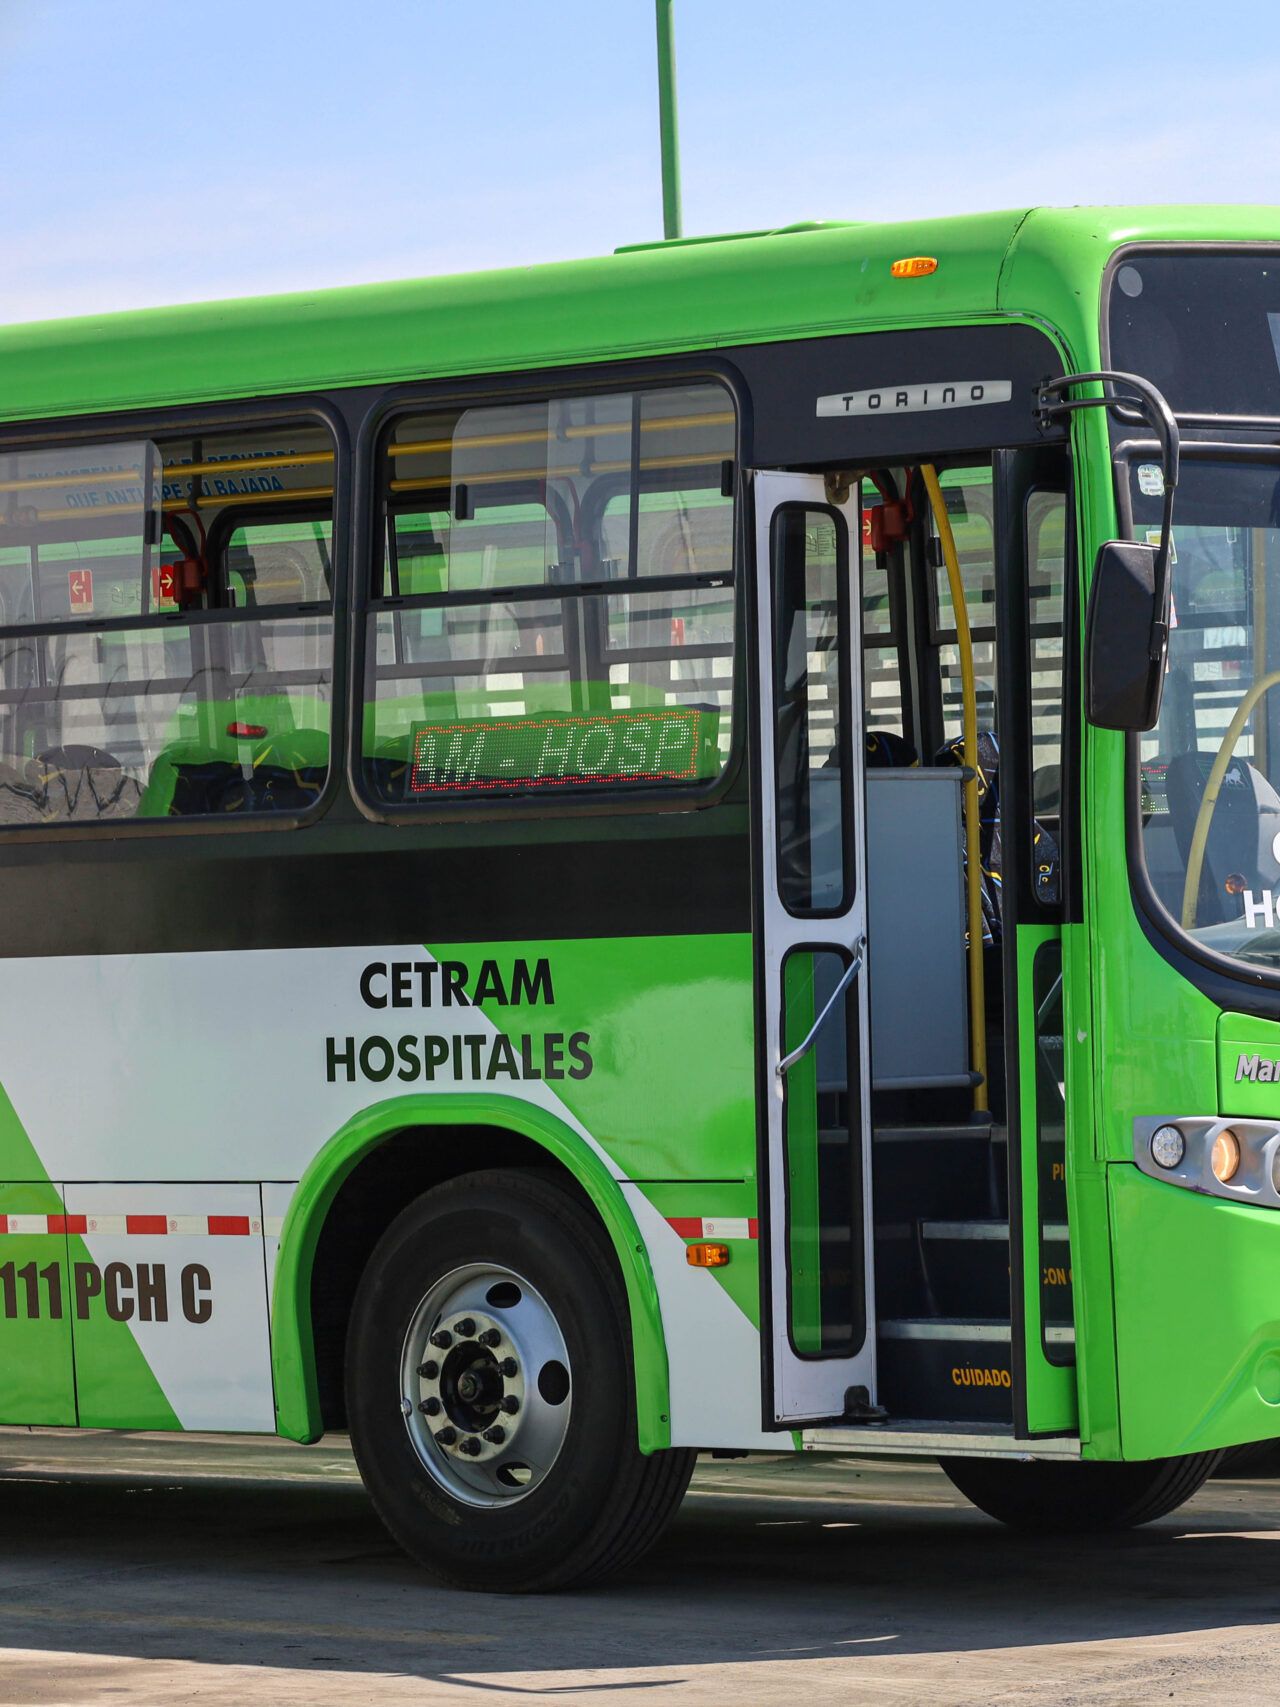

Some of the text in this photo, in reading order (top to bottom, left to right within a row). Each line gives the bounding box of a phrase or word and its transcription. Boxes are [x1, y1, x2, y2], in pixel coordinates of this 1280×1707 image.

[842, 385, 984, 411] TORINO
[213, 475, 284, 496] BAJADA
[533, 720, 690, 777] HOSP
[359, 958, 555, 1009] CETRAM
[325, 1032, 594, 1083] HOSPITALES
[0, 1261, 212, 1324] 111 PCH C
[952, 1368, 1011, 1388] CUIDADO
